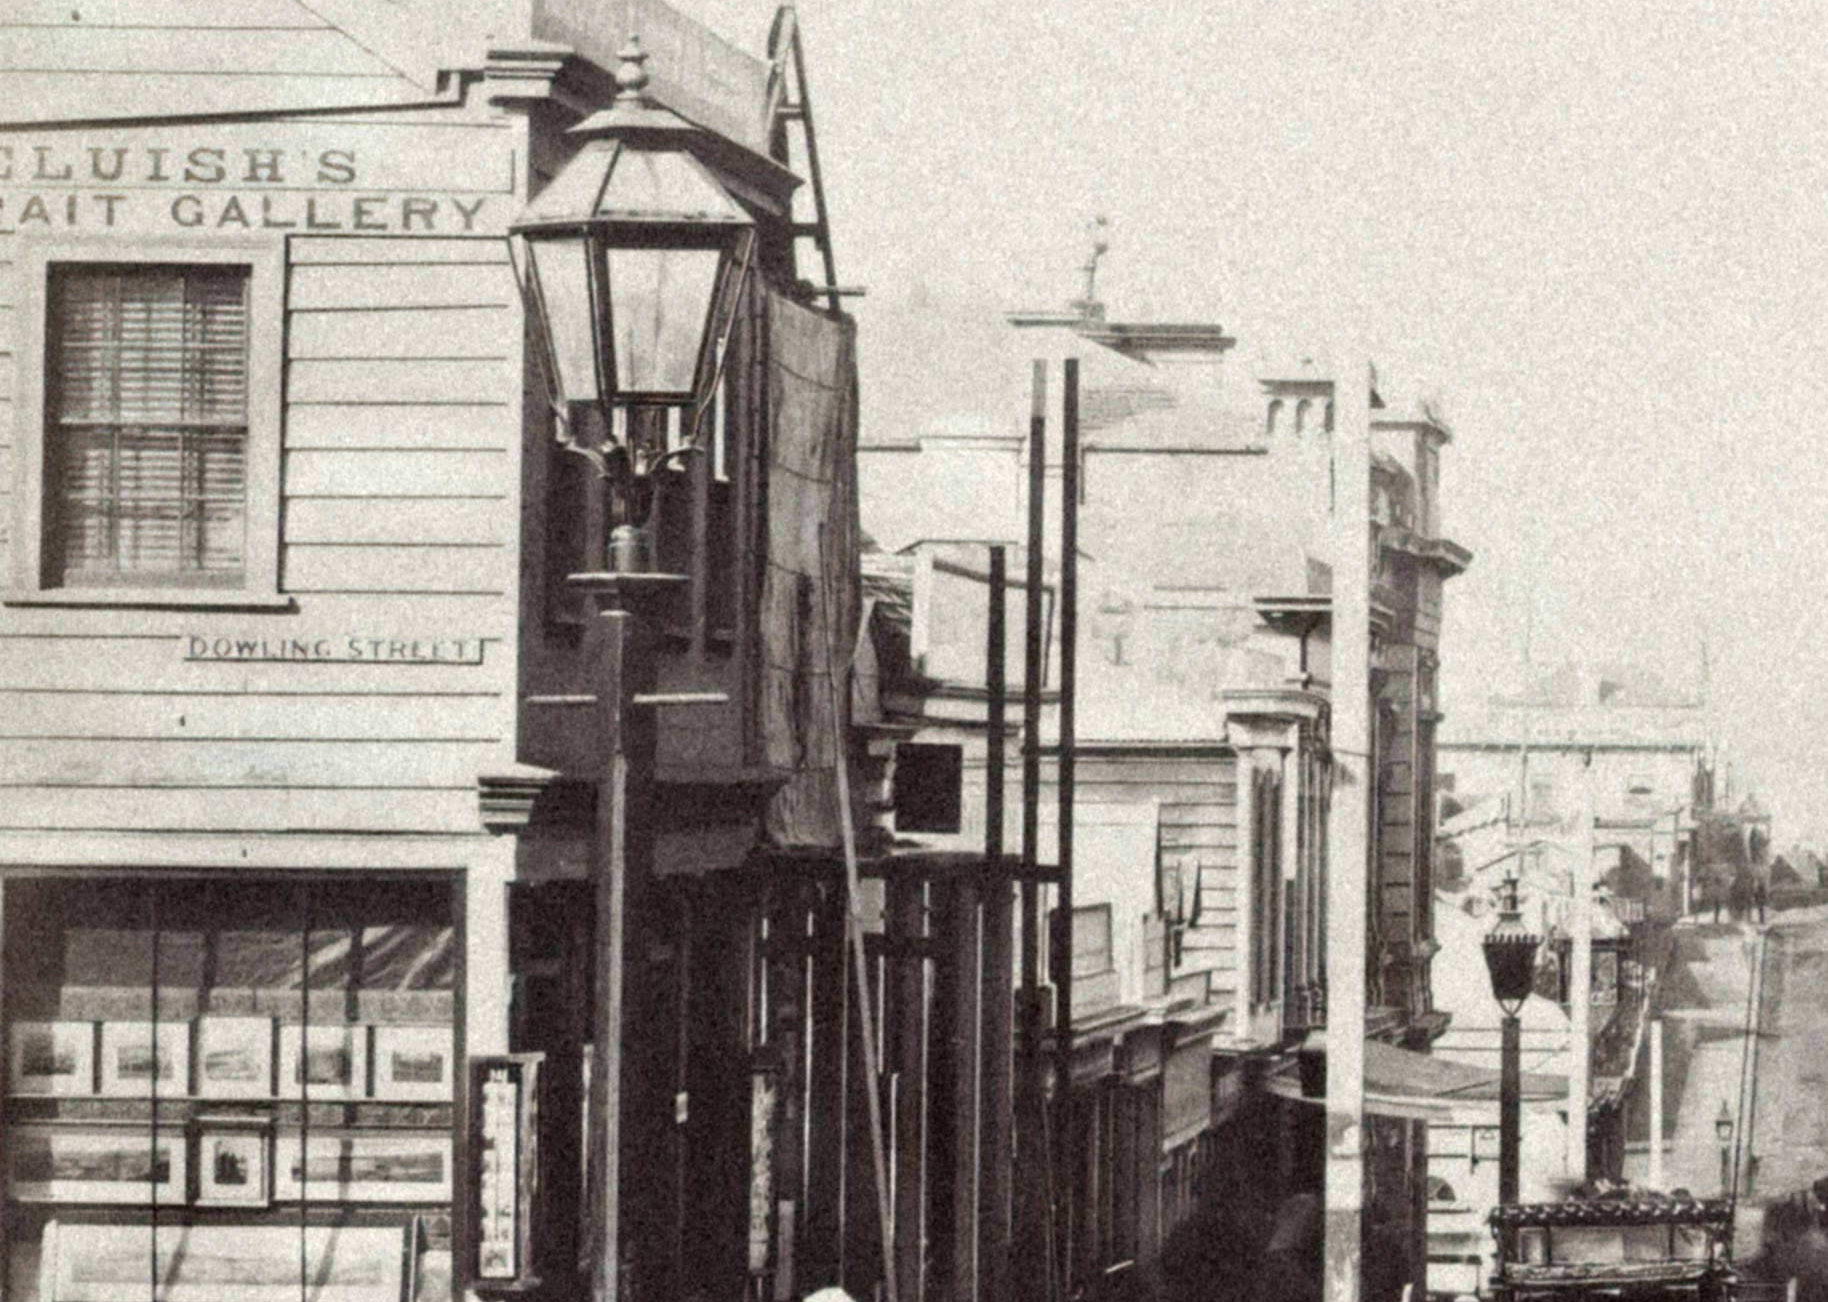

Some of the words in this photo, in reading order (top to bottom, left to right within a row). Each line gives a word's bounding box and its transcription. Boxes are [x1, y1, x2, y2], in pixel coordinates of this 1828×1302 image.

[0, 195, 128, 226] AIT
[170, 195, 486, 231] GALLERY
[189, 637, 331, 658] DOWLING
[349, 638, 466, 660] STREET
